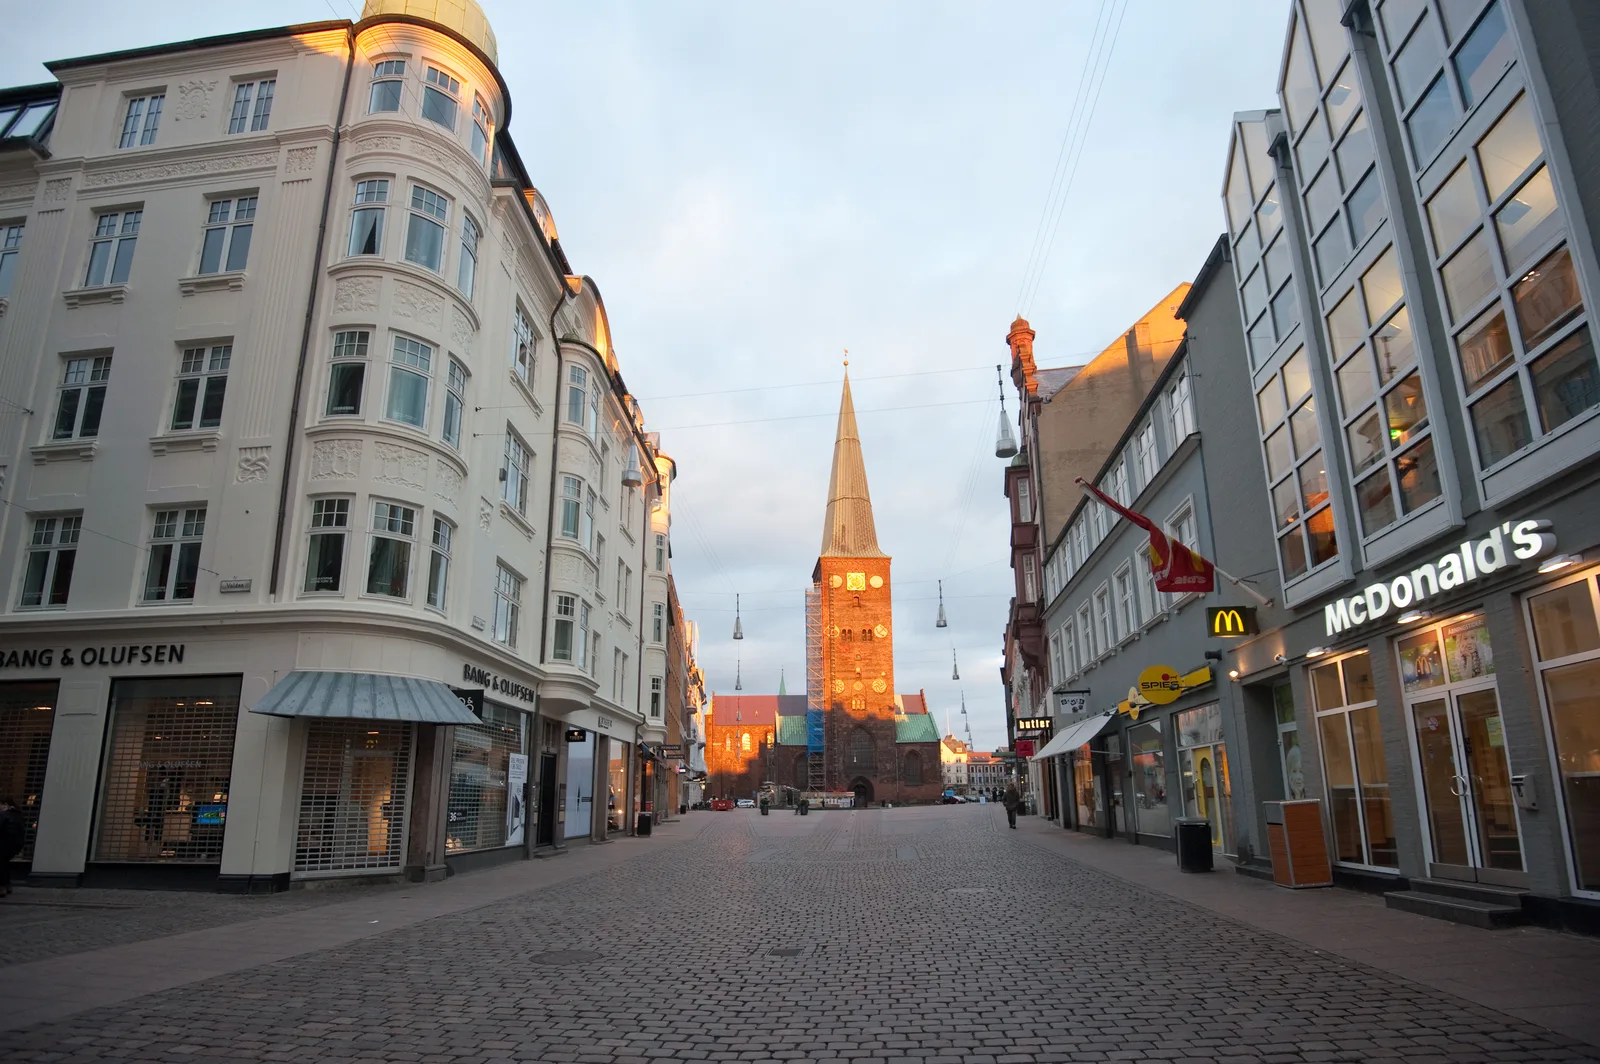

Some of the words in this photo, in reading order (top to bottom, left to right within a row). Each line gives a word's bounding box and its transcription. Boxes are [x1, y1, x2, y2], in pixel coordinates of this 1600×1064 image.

[1174, 575, 1206, 585] ald's
[1324, 519, 1544, 637] McDonald's
[61, 648, 74, 666] &
[80, 644, 185, 666] OLUFSEN
[463, 663, 491, 689] BANG
[493, 675, 499, 691] &
[500, 678, 535, 704] OLUFSEN
[1141, 680, 1180, 690] SPIES
[1019, 719, 1051, 729] butler
[449, 812, 457, 822] 36
